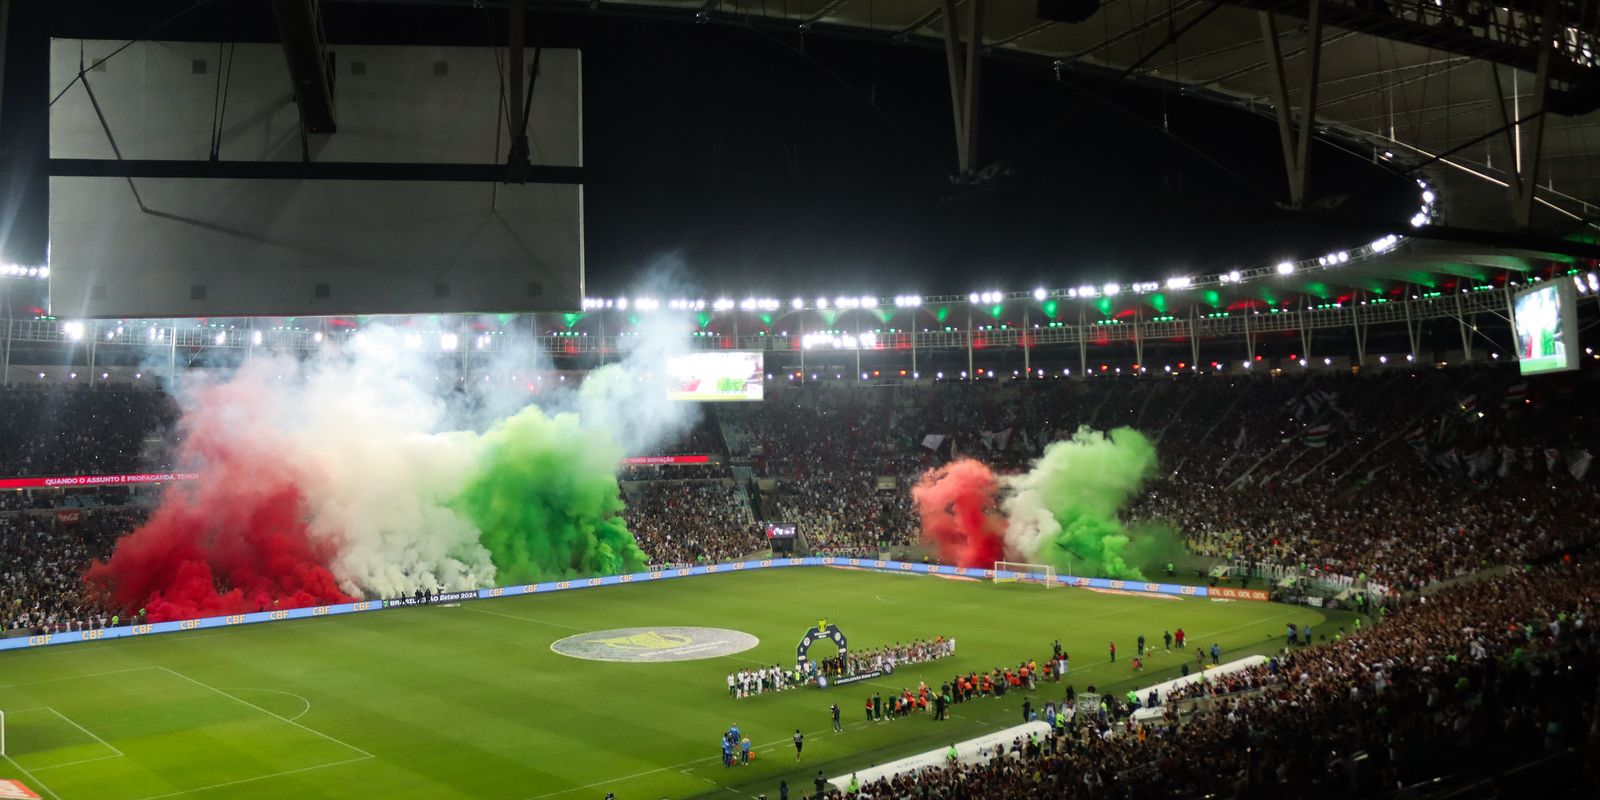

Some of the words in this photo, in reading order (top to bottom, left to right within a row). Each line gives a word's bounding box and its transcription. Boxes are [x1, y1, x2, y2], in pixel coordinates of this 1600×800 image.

[45, 477, 78, 486] QUANDO
[121, 474, 126, 482] É
[127, 473, 176, 481] PROPAGANDA,
[733, 562, 745, 570] CBF
[760, 559, 773, 568] CBF
[789, 557, 804, 566] CBF
[874, 560, 886, 568] CBF
[901, 562, 913, 570] CBF
[678, 568, 691, 577] CBF
[706, 565, 719, 573] CBF
[927, 564, 939, 573] CBF
[955, 567, 968, 575] CBF
[619, 574, 633, 583] CBF
[649, 571, 663, 580] CBF
[556, 580, 571, 590] CBF
[588, 577, 604, 586] CBF
[1109, 579, 1125, 589] CBF
[489, 587, 504, 597] CBF
[523, 584, 539, 593] CBF
[1144, 582, 1160, 592] CBF
[1180, 585, 1197, 595] CBF
[312, 606, 330, 616] CBF
[353, 602, 371, 612] CBF
[226, 614, 246, 625] CBF
[269, 610, 289, 621] CBF
[132, 624, 153, 635] CBF
[180, 619, 201, 630] CBF
[82, 629, 104, 640] CBF
[29, 634, 52, 646] CBF
